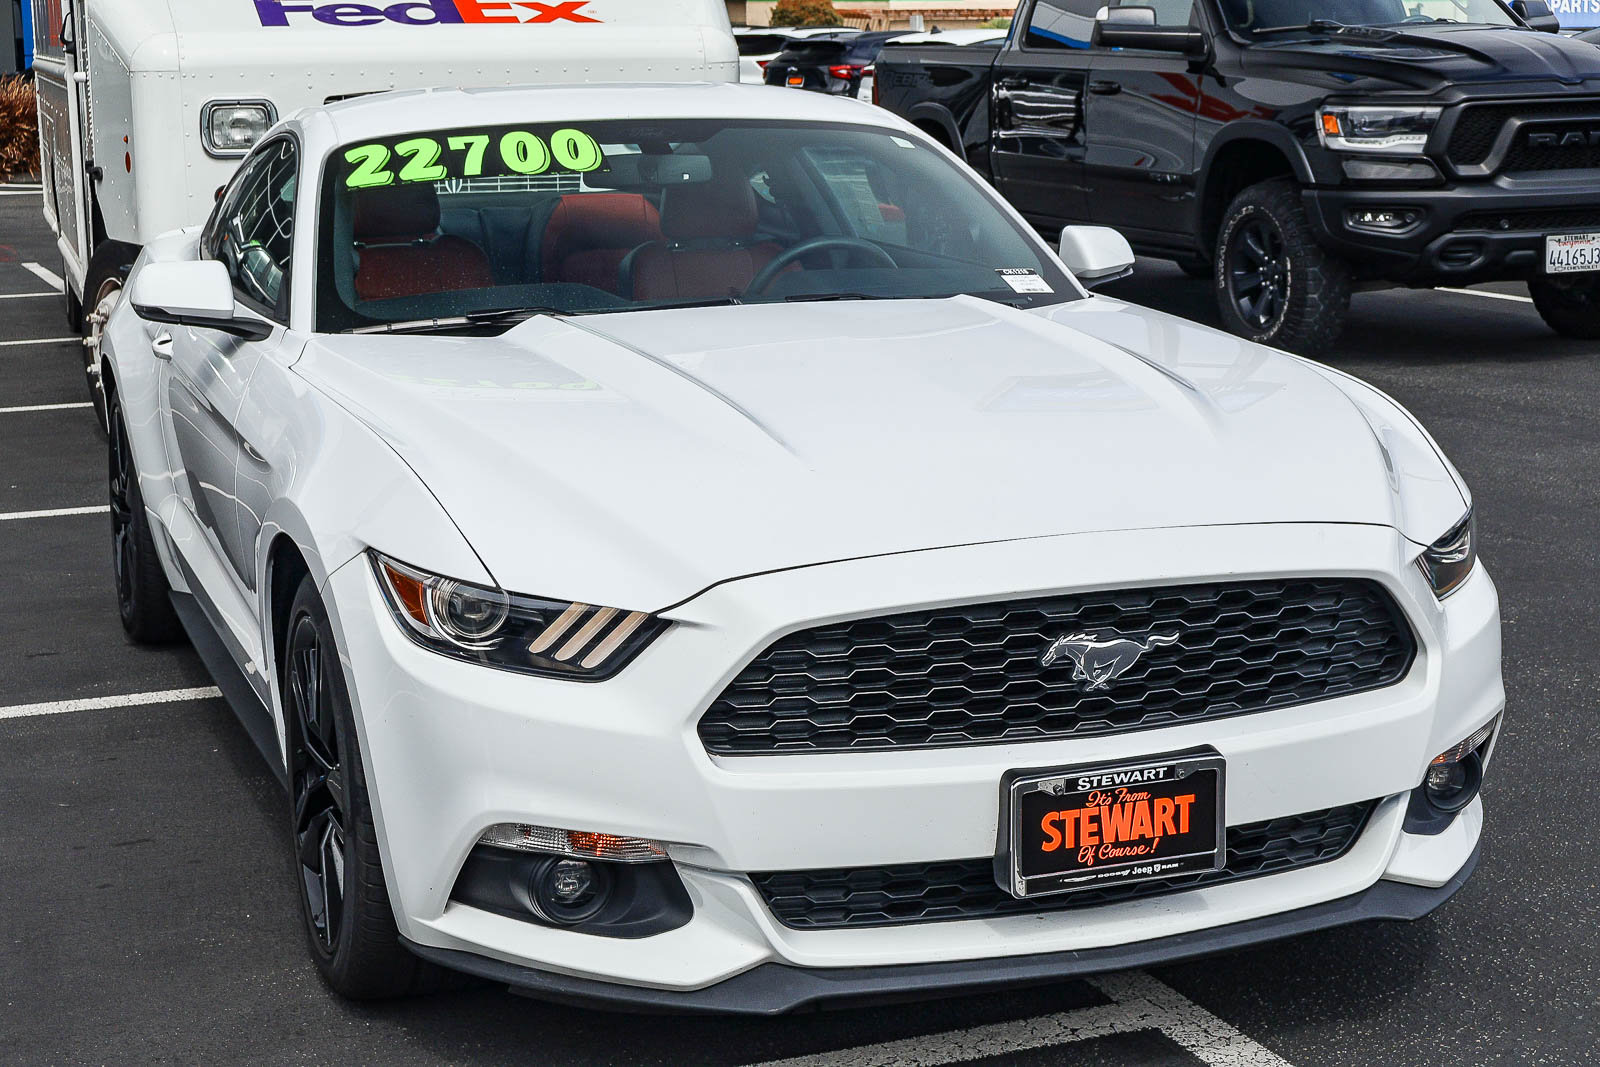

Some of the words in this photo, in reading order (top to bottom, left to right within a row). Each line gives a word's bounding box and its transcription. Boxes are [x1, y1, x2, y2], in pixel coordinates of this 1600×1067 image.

[254, 0, 605, 27] FedEx
[1551, 0, 1600, 14] PARTS
[344, 128, 602, 188] 22700
[1549, 247, 1600, 266] 44165J3
[1077, 766, 1168, 791] STEWART
[1115, 787, 1151, 804] From
[1040, 793, 1196, 852] STEWART
[1077, 844, 1096, 866] Of
[1131, 865, 1153, 875] Jeep
